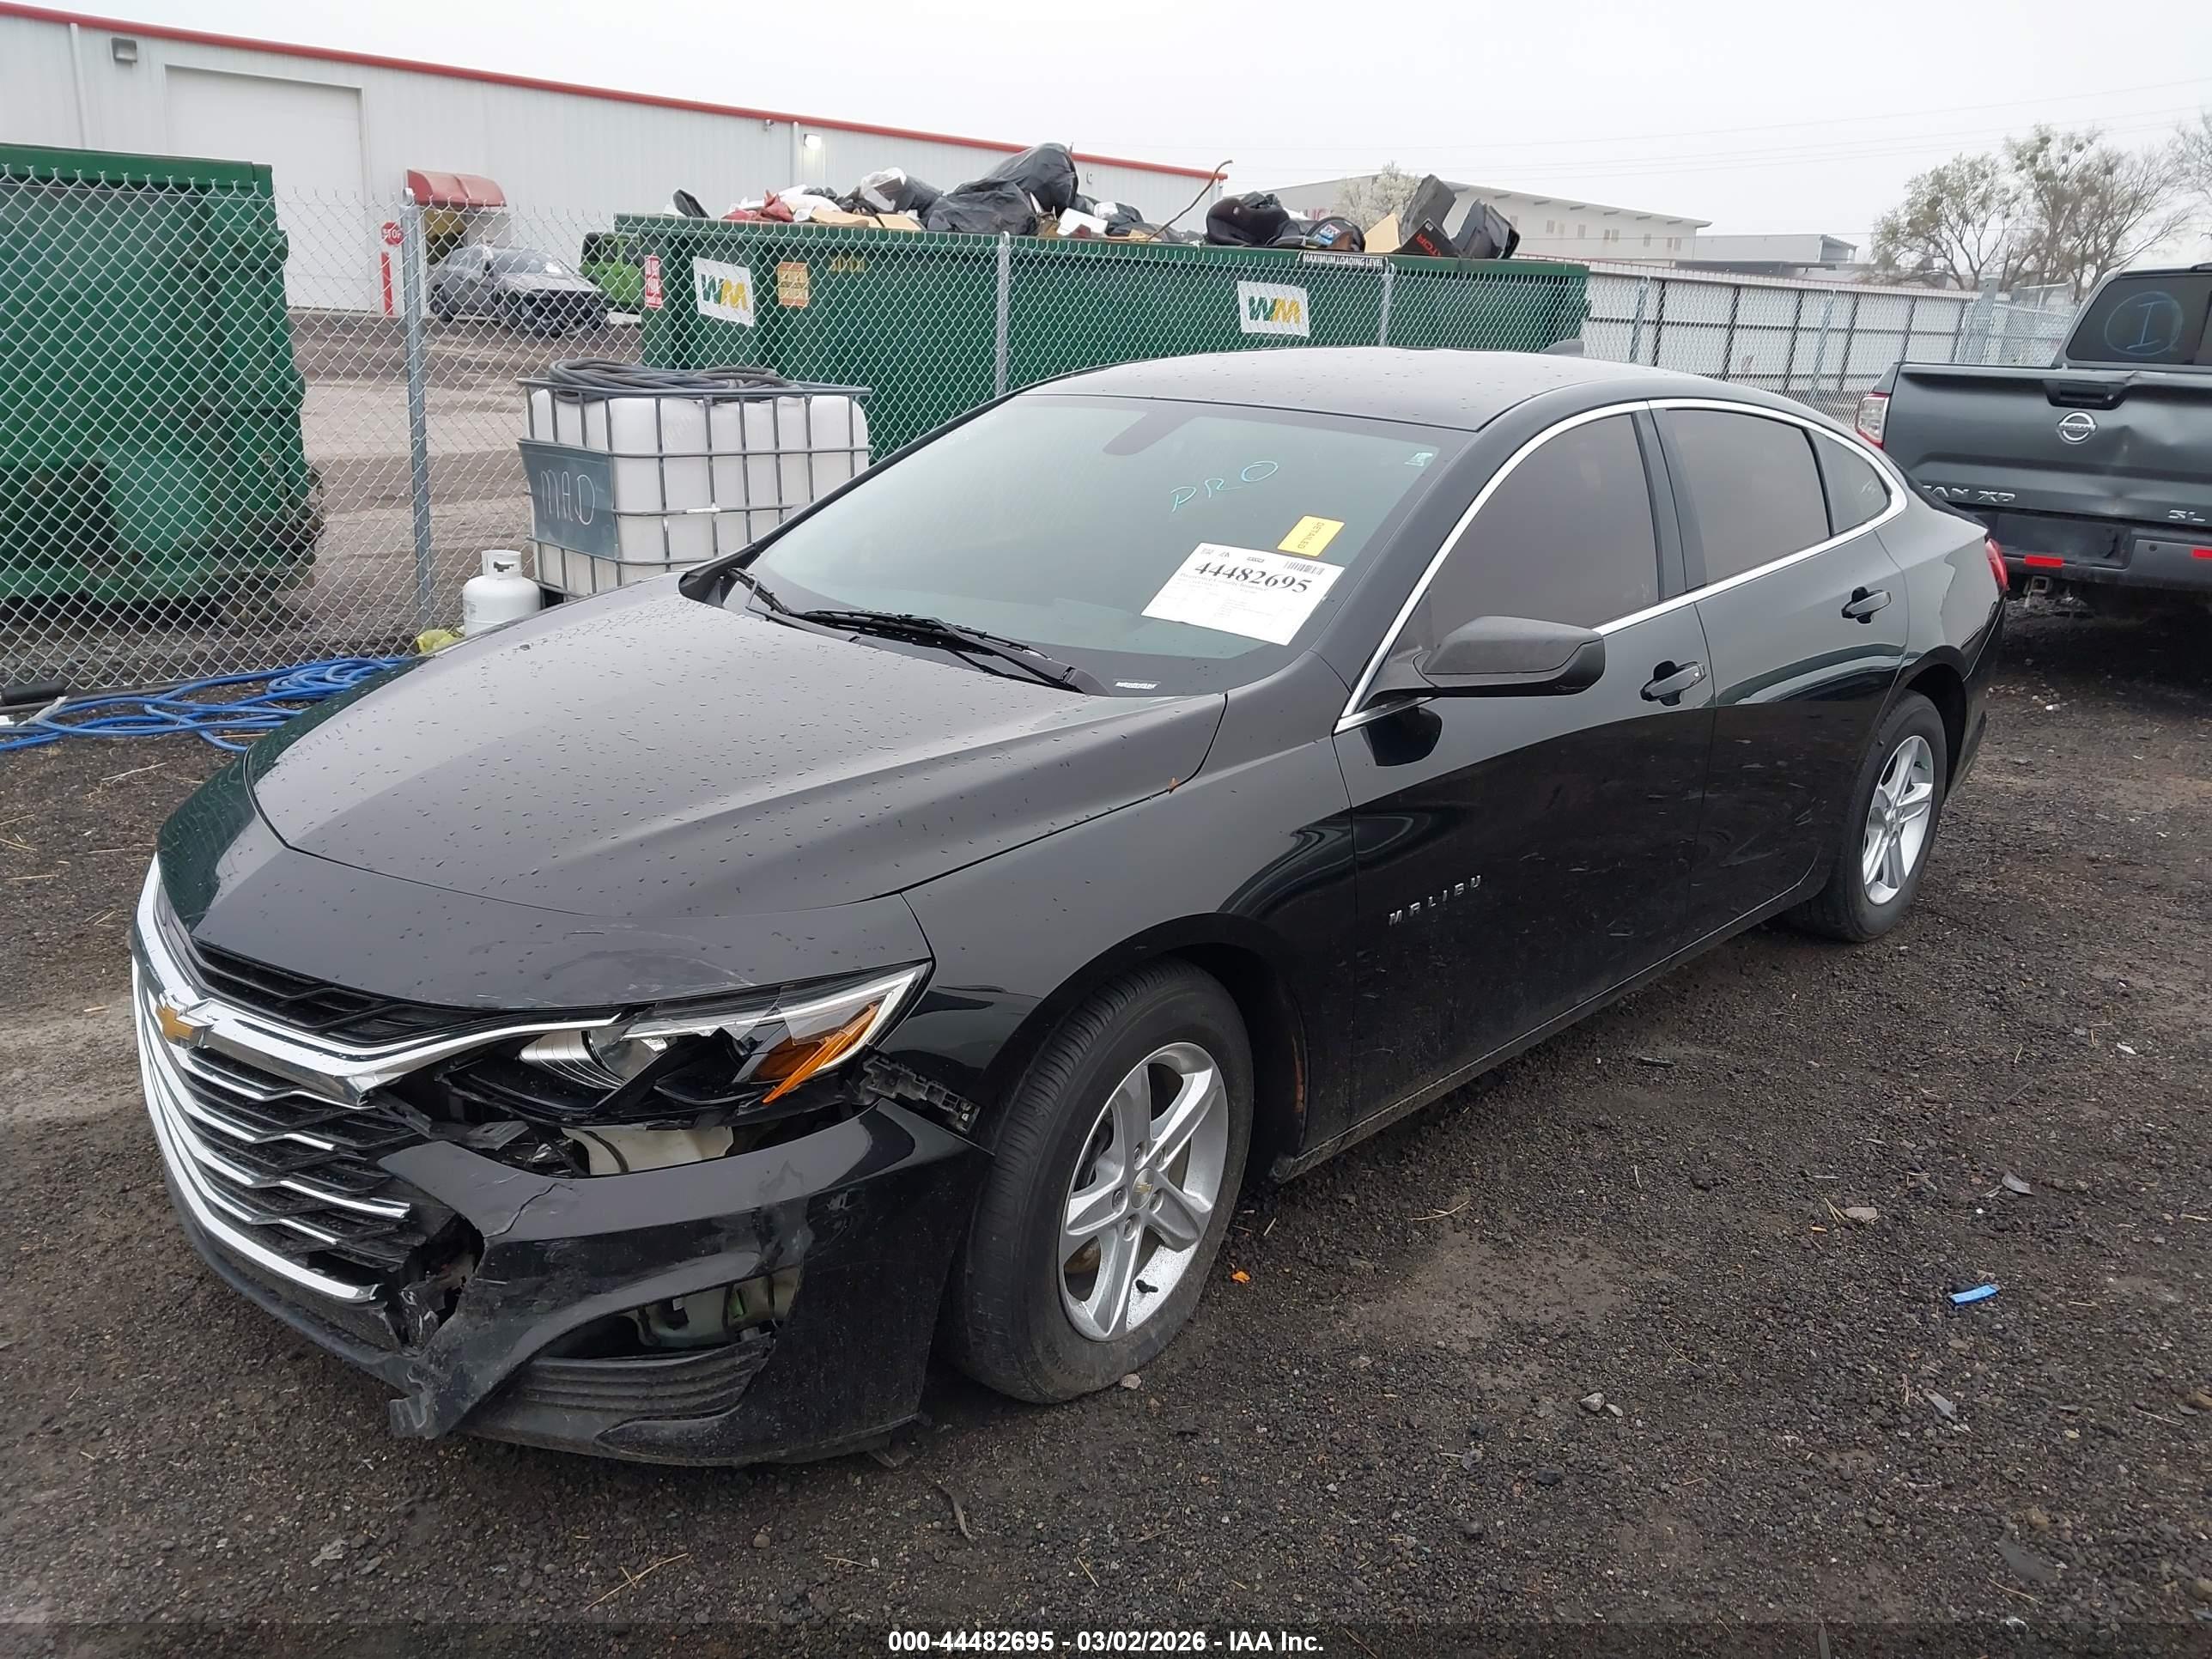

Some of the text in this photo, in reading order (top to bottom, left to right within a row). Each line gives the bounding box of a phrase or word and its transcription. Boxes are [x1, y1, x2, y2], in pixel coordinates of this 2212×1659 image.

[1303, 253, 1383, 267] MAXIMUM LOADING LEVEL
[701, 274, 748, 311] WM
[1248, 295, 1301, 325] WM
[1170, 460, 1278, 513] PRO
[2168, 509, 2206, 522] SL
[1194, 562, 1313, 592] 44482695
[1389, 875, 1481, 927] MALIBU
